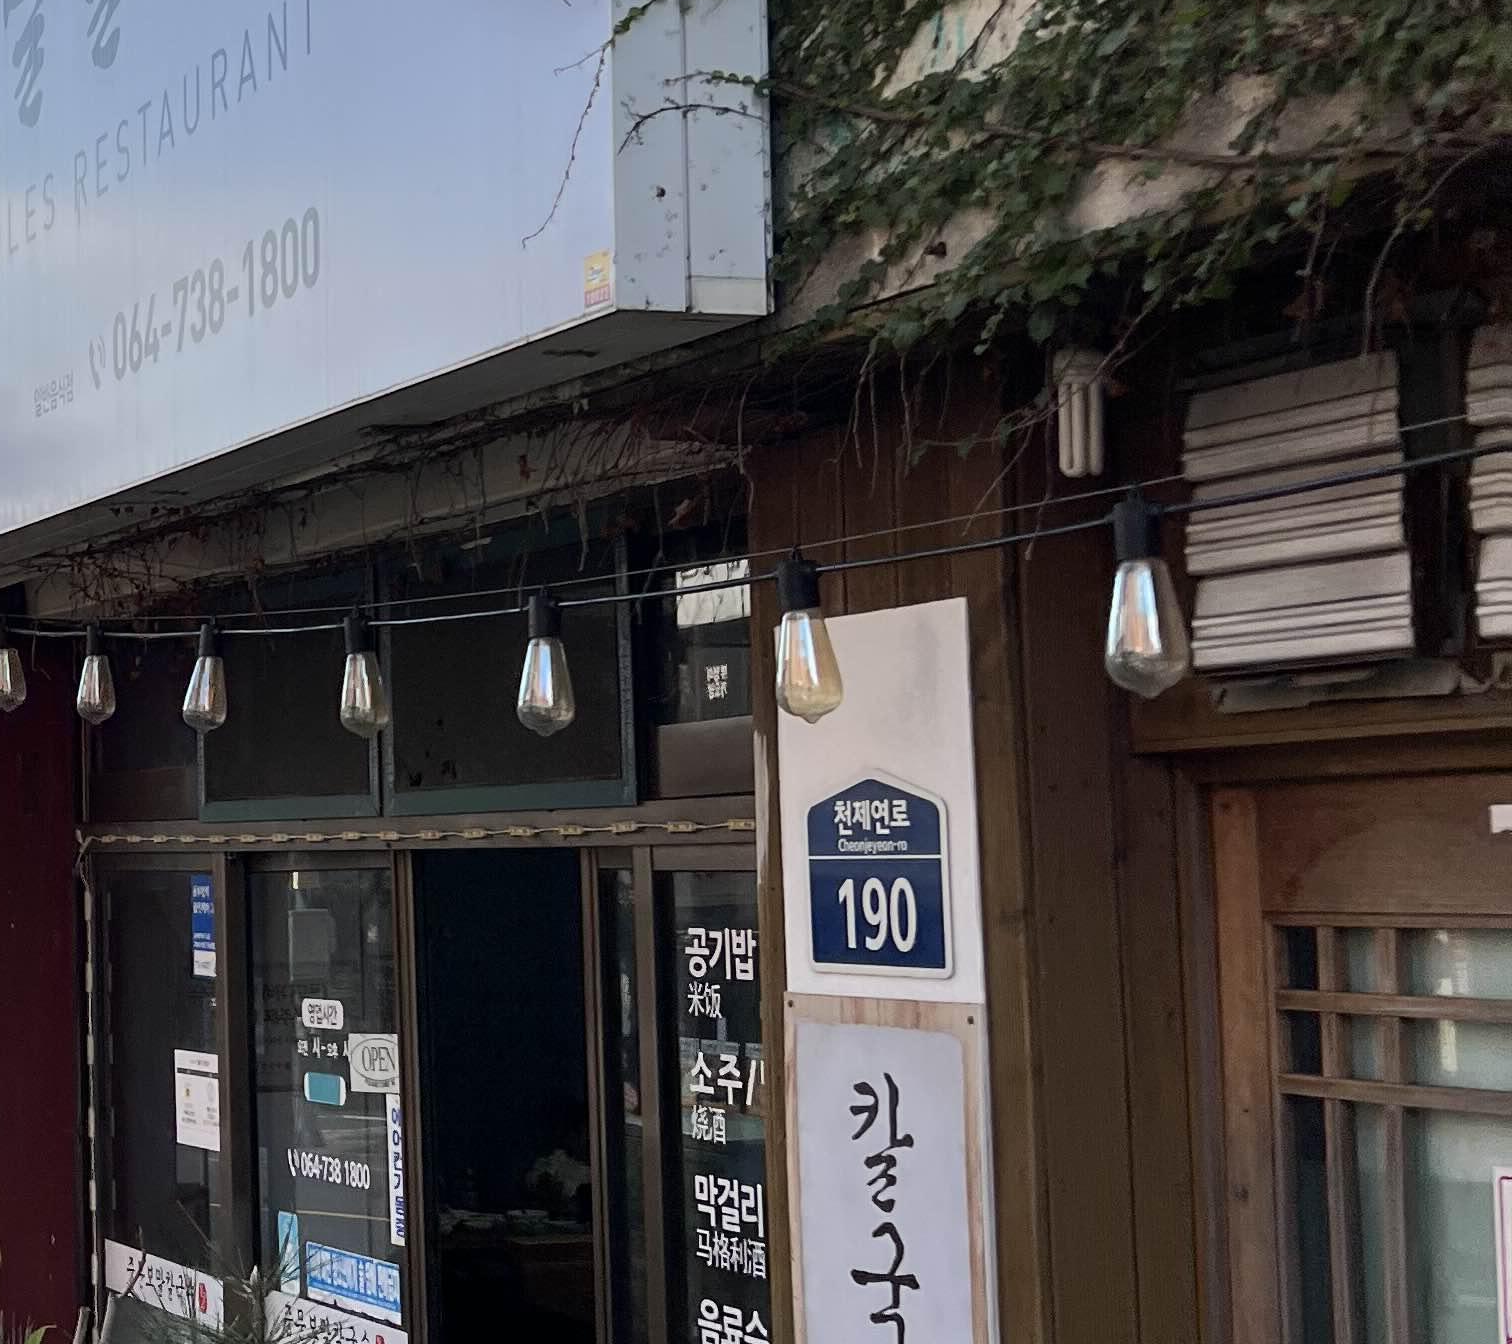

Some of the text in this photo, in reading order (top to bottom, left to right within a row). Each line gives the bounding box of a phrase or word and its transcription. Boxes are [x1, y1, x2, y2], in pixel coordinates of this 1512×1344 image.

[112, 206, 321, 382] 064-738-1800
[833, 798, 911, 836] 천제연로
[838, 837, 908, 855] Cheonjeyeon-ro
[838, 877, 918, 953] 190
[685, 927, 757, 981] 공기밥
[687, 981, 723, 1019] 米饭
[362, 1046, 396, 1072] OPEN
[691, 1104, 727, 1145] 烧酒
[694, 1174, 765, 1239] 막걸리
[695, 1228, 767, 1280] 马格利酒
